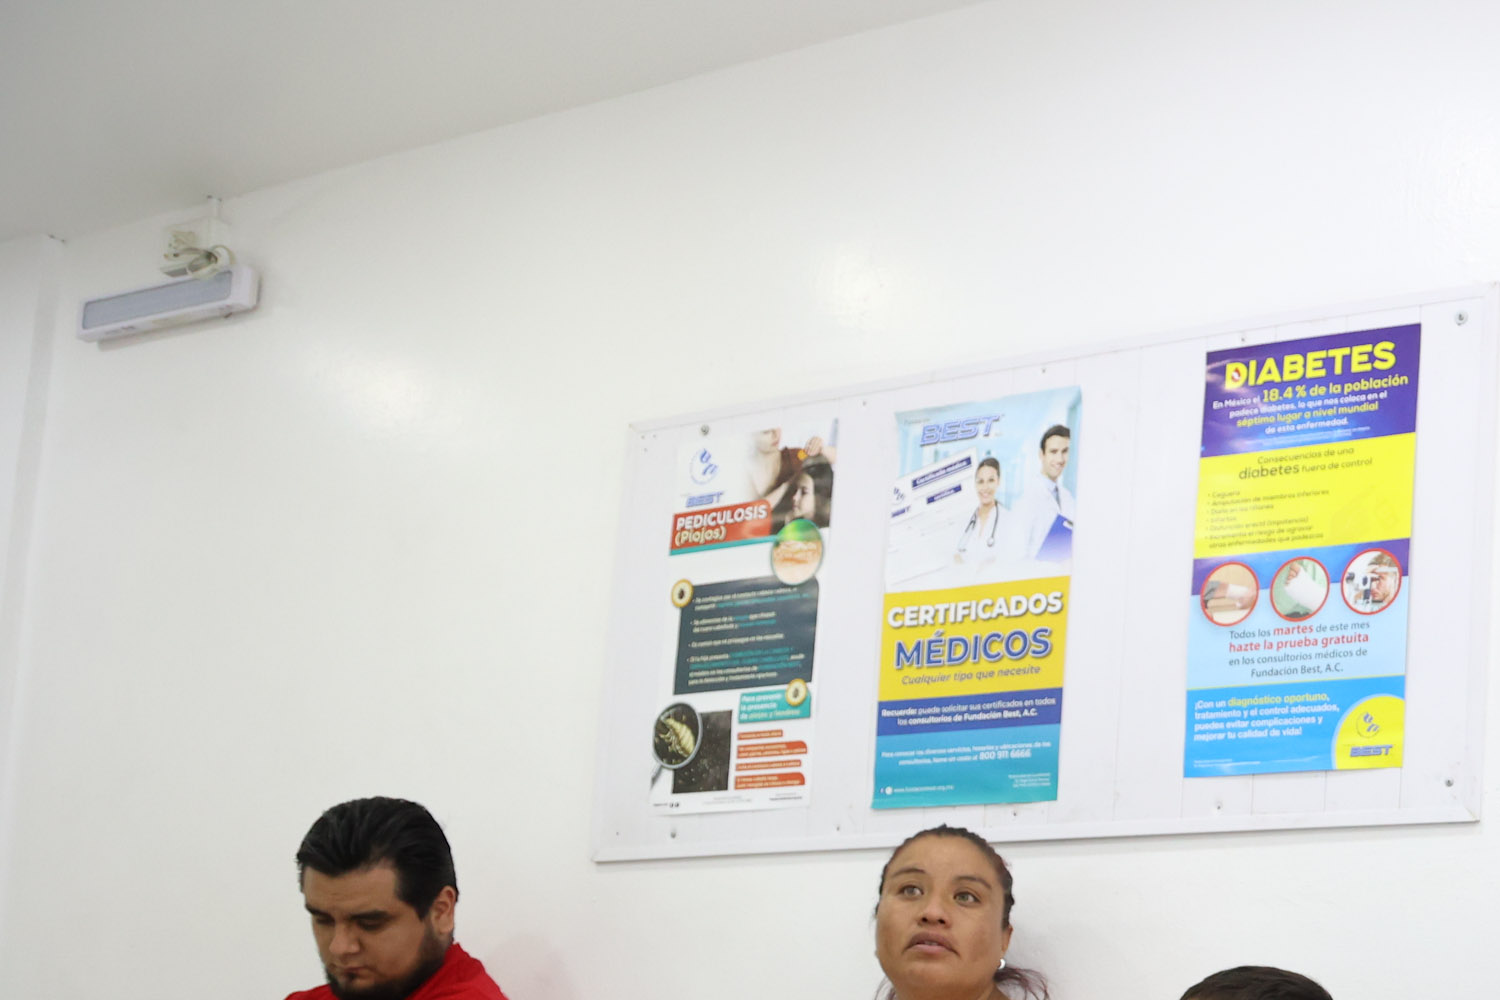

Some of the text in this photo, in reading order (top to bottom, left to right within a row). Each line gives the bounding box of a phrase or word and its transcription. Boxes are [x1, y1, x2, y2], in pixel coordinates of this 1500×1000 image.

[1224, 341, 1396, 388] DIABETES
[1224, 397, 1251, 407] México
[1263, 386, 1293, 402] 18.4
[1310, 384, 1325, 396] de
[1329, 382, 1341, 394] la
[1344, 374, 1408, 395] población
[1237, 415, 1275, 427] séptimo
[1277, 412, 1300, 424] lugar
[1313, 407, 1336, 417] nivel
[1338, 401, 1378, 414] mundial
[920, 415, 1000, 447] BEST
[1258, 452, 1321, 464] Consecuencias
[1337, 448, 1354, 456] una
[1239, 458, 1373, 479] diabetes fuera de control
[676, 505, 767, 531] PEDICULOSIS
[675, 526, 726, 546] (Piojos)
[888, 591, 1063, 628] CERTIFICADOS
[1230, 622, 1370, 639] Todos los martes de este mes
[895, 627, 1052, 669] MÉDICOS
[1229, 633, 1369, 652] hazte la prueba gratuita
[1242, 656, 1254, 665] los
[1257, 651, 1312, 664] consultorios
[1315, 648, 1353, 659] médicos
[1356, 648, 1367, 657] de
[902, 664, 1040, 685] Cualquier tipo que necesite
[1251, 663, 1343, 678] Fundación Best, A.C.
[1229, 695, 1282, 708] diagnóstico
[1195, 710, 1241, 720] tratamiento
[1259, 706, 1288, 715] control
[1251, 716, 1316, 728] complicaciones
